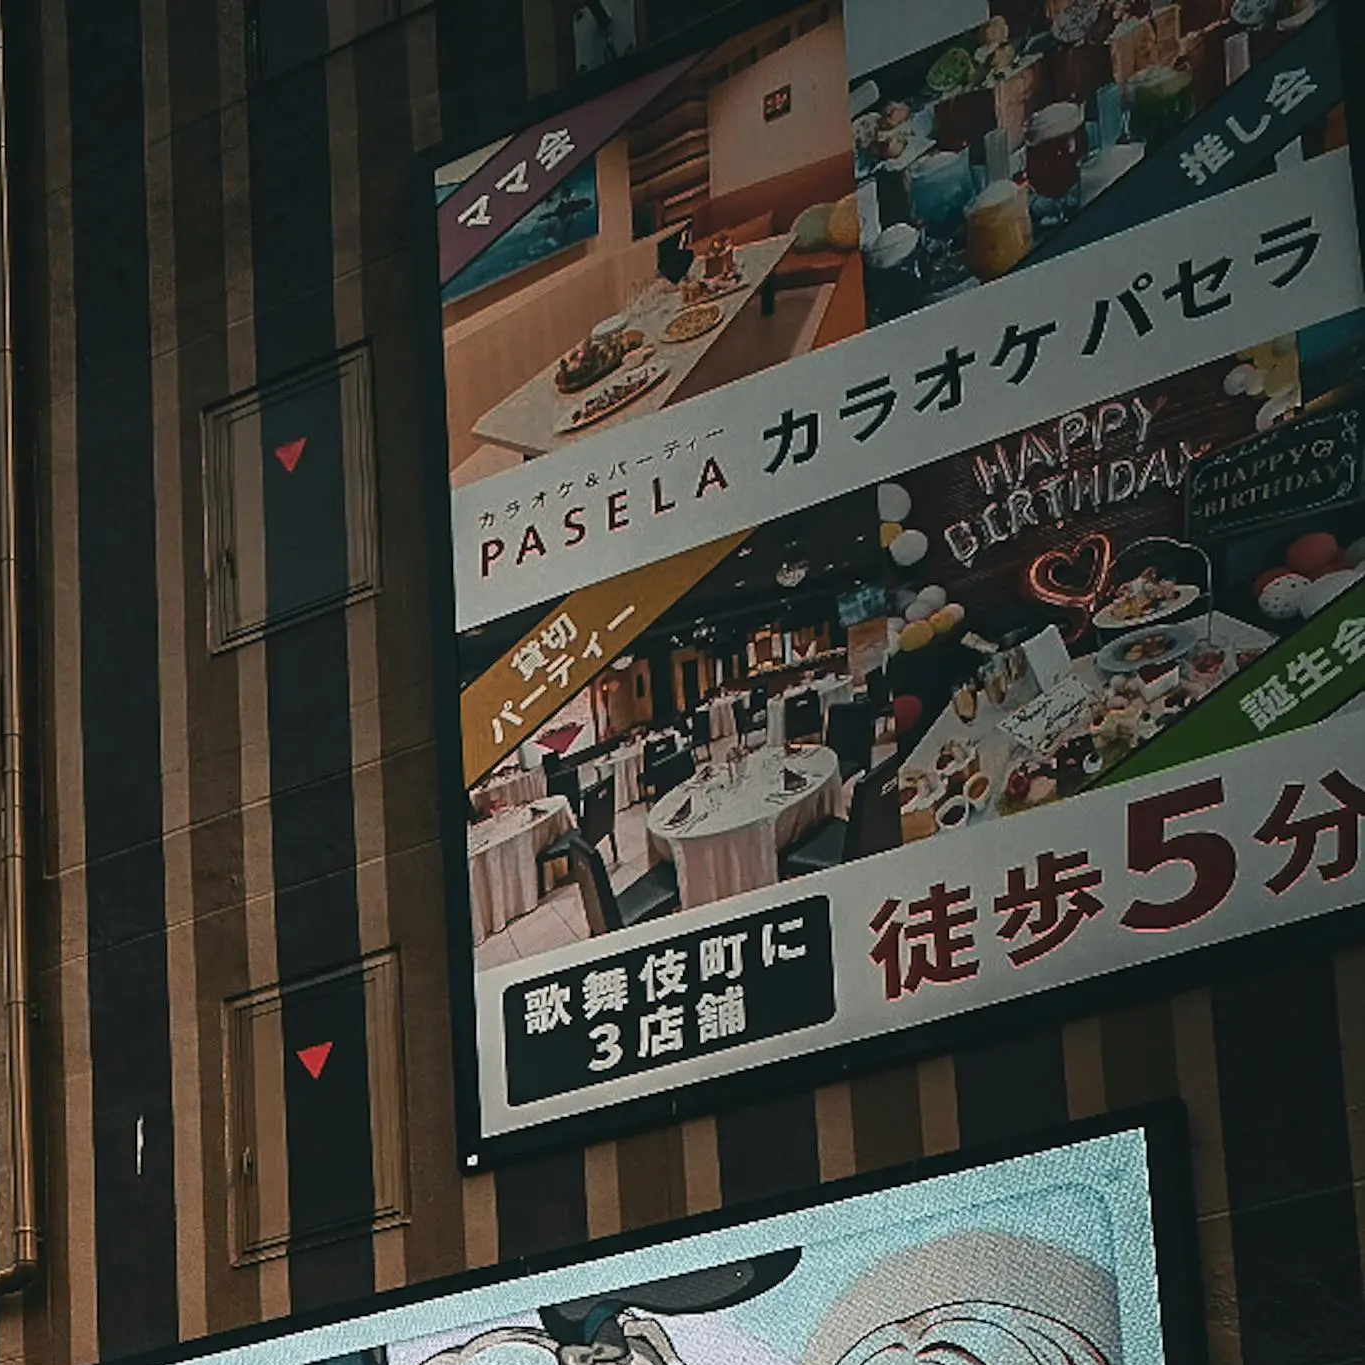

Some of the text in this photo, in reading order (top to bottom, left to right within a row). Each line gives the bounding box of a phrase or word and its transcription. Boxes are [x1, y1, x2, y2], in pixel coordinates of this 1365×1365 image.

[457, 126, 576, 230] ママ会
[1179, 62, 1320, 188] 推し会
[943, 441, 1214, 568] BIRTHDAY
[972, 396, 1168, 496] HAPPY
[479, 455, 732, 578] PASELA
[490, 603, 637, 745] パーティー
[510, 610, 580, 684] 貸切
[1237, 612, 1365, 733] 誕生会
[868, 767, 1365, 1001] 徒歩5分
[523, 912, 807, 1036] 歌舞伎町に
[585, 983, 747, 1074] 3店舗
